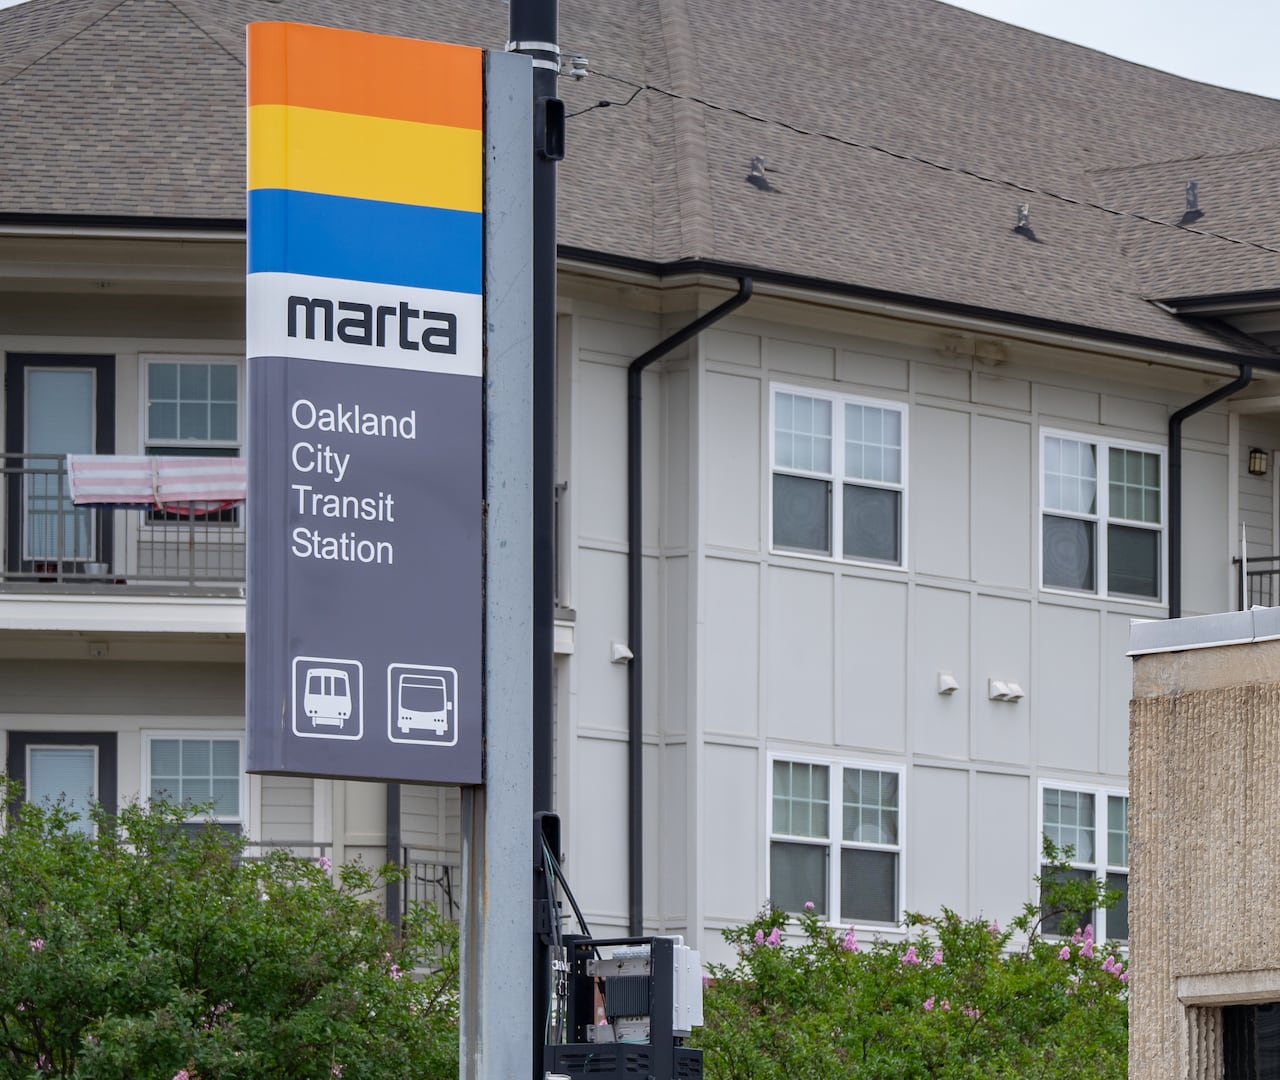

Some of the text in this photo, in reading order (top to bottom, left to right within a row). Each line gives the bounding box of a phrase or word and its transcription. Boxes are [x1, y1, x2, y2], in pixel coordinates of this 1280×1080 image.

[287, 295, 457, 355] marta
[291, 399, 416, 440] Oakland
[291, 441, 350, 483] City
[291, 484, 394, 522] Transit
[291, 527, 393, 565] Station
